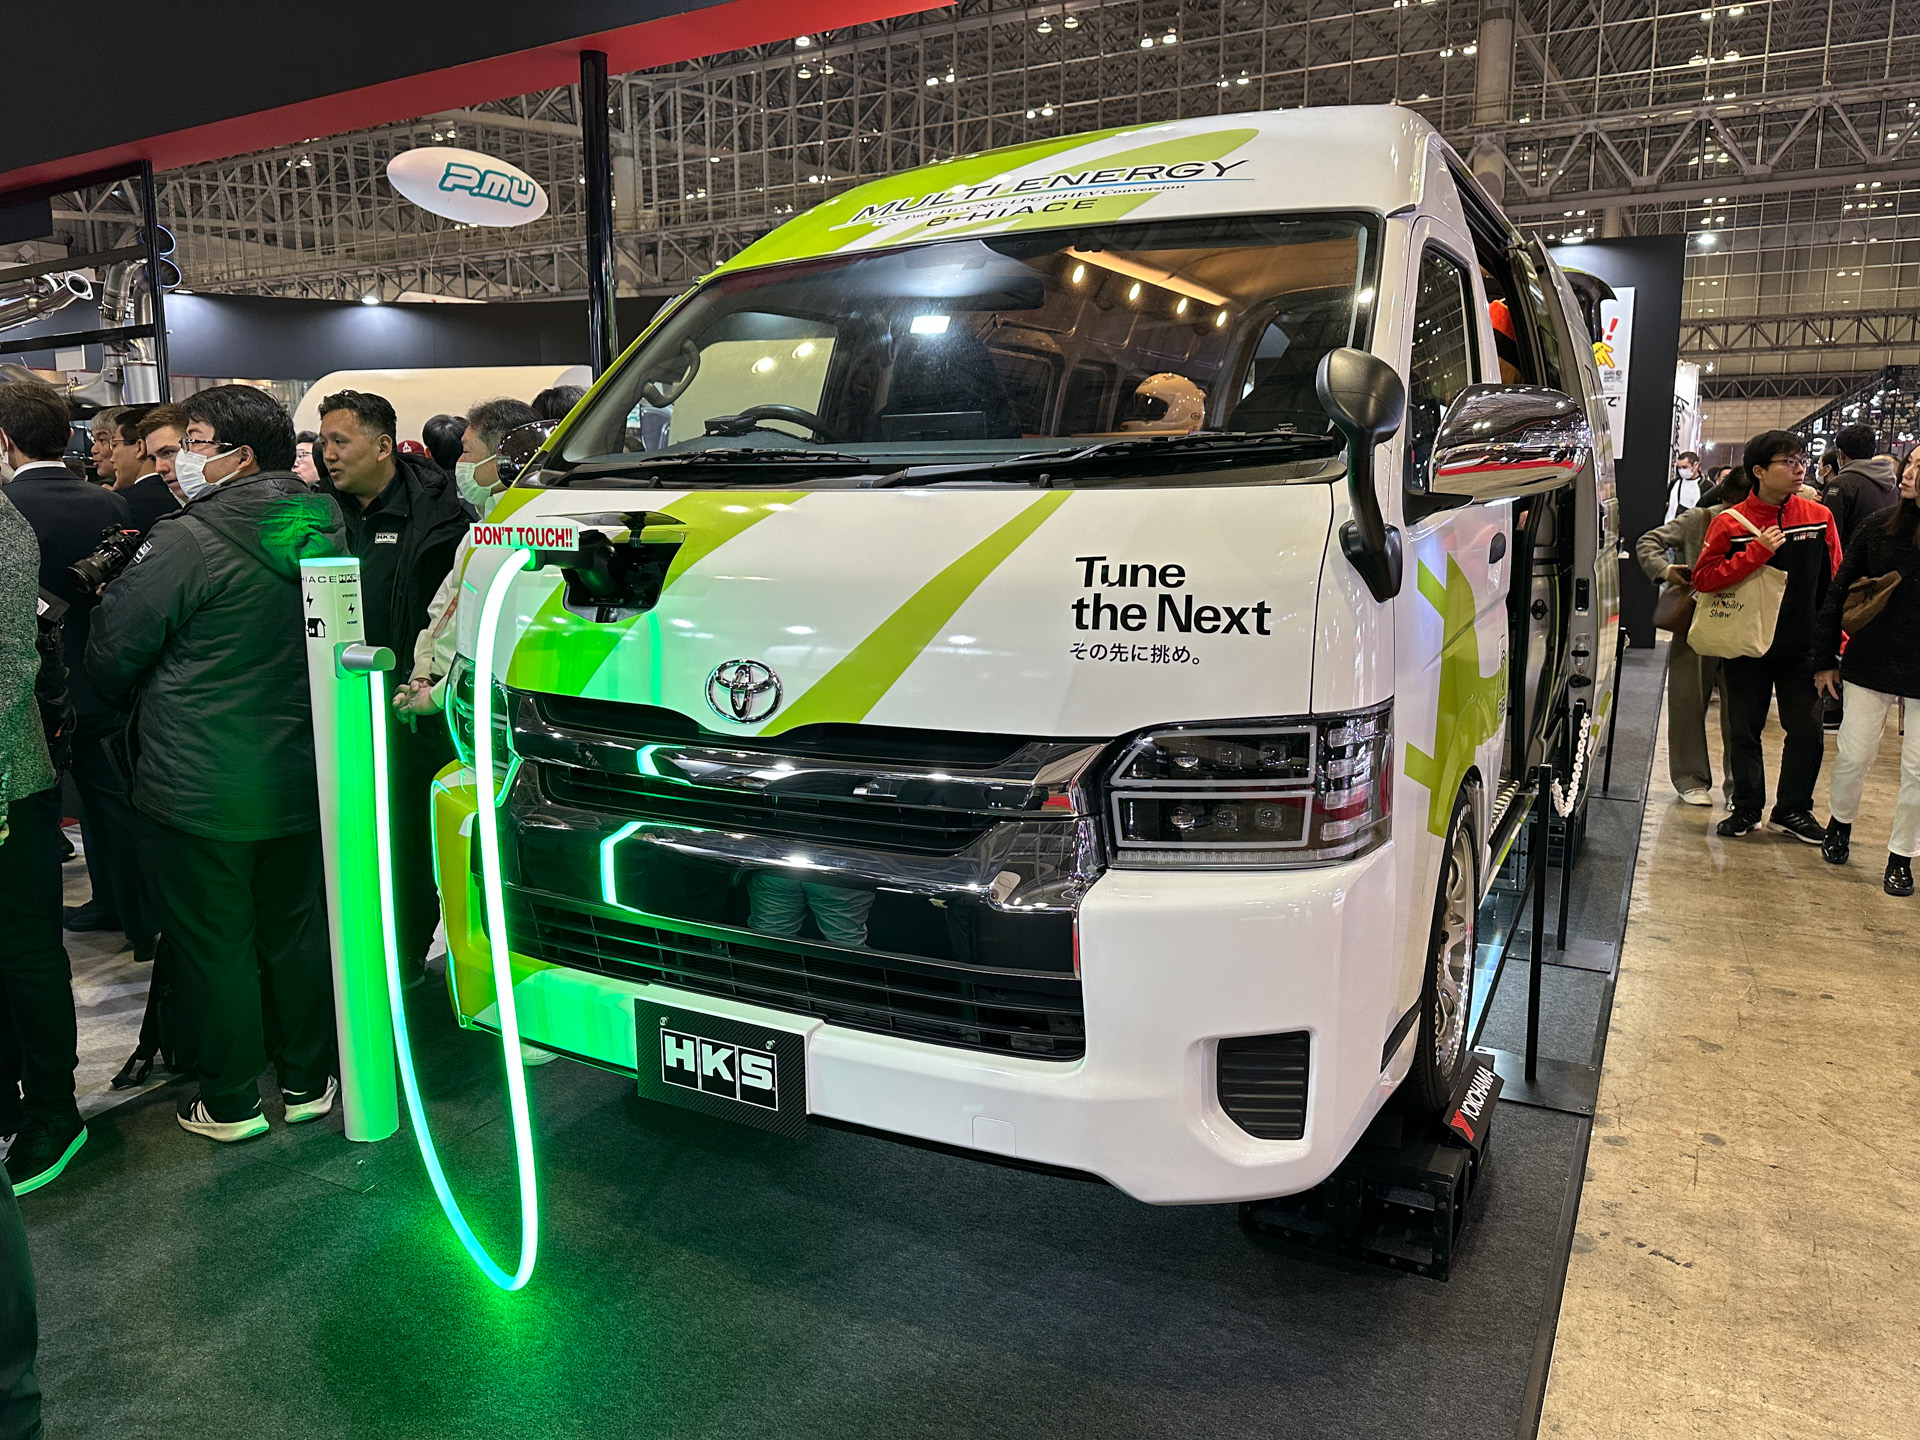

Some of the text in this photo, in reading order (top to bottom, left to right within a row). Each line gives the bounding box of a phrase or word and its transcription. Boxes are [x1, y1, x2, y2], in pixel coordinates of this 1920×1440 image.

[851, 160, 1249, 222] MULTI ENERGY
[1101, 184, 1185, 195] Conversion
[926, 198, 1098, 227] e-HIACE
[474, 526, 573, 548] DON'T TOUCH!!
[1075, 556, 1186, 588] Tune
[1711, 600, 1745, 612] Mobility
[1712, 591, 1736, 600] Japan
[1071, 593, 1272, 636] the Next
[1709, 609, 1732, 618] Show
[1070, 643, 1200, 665] その先に挑め。
[664, 1034, 773, 1091] HKS
[1460, 1065, 1496, 1122] YOKOHAMA
